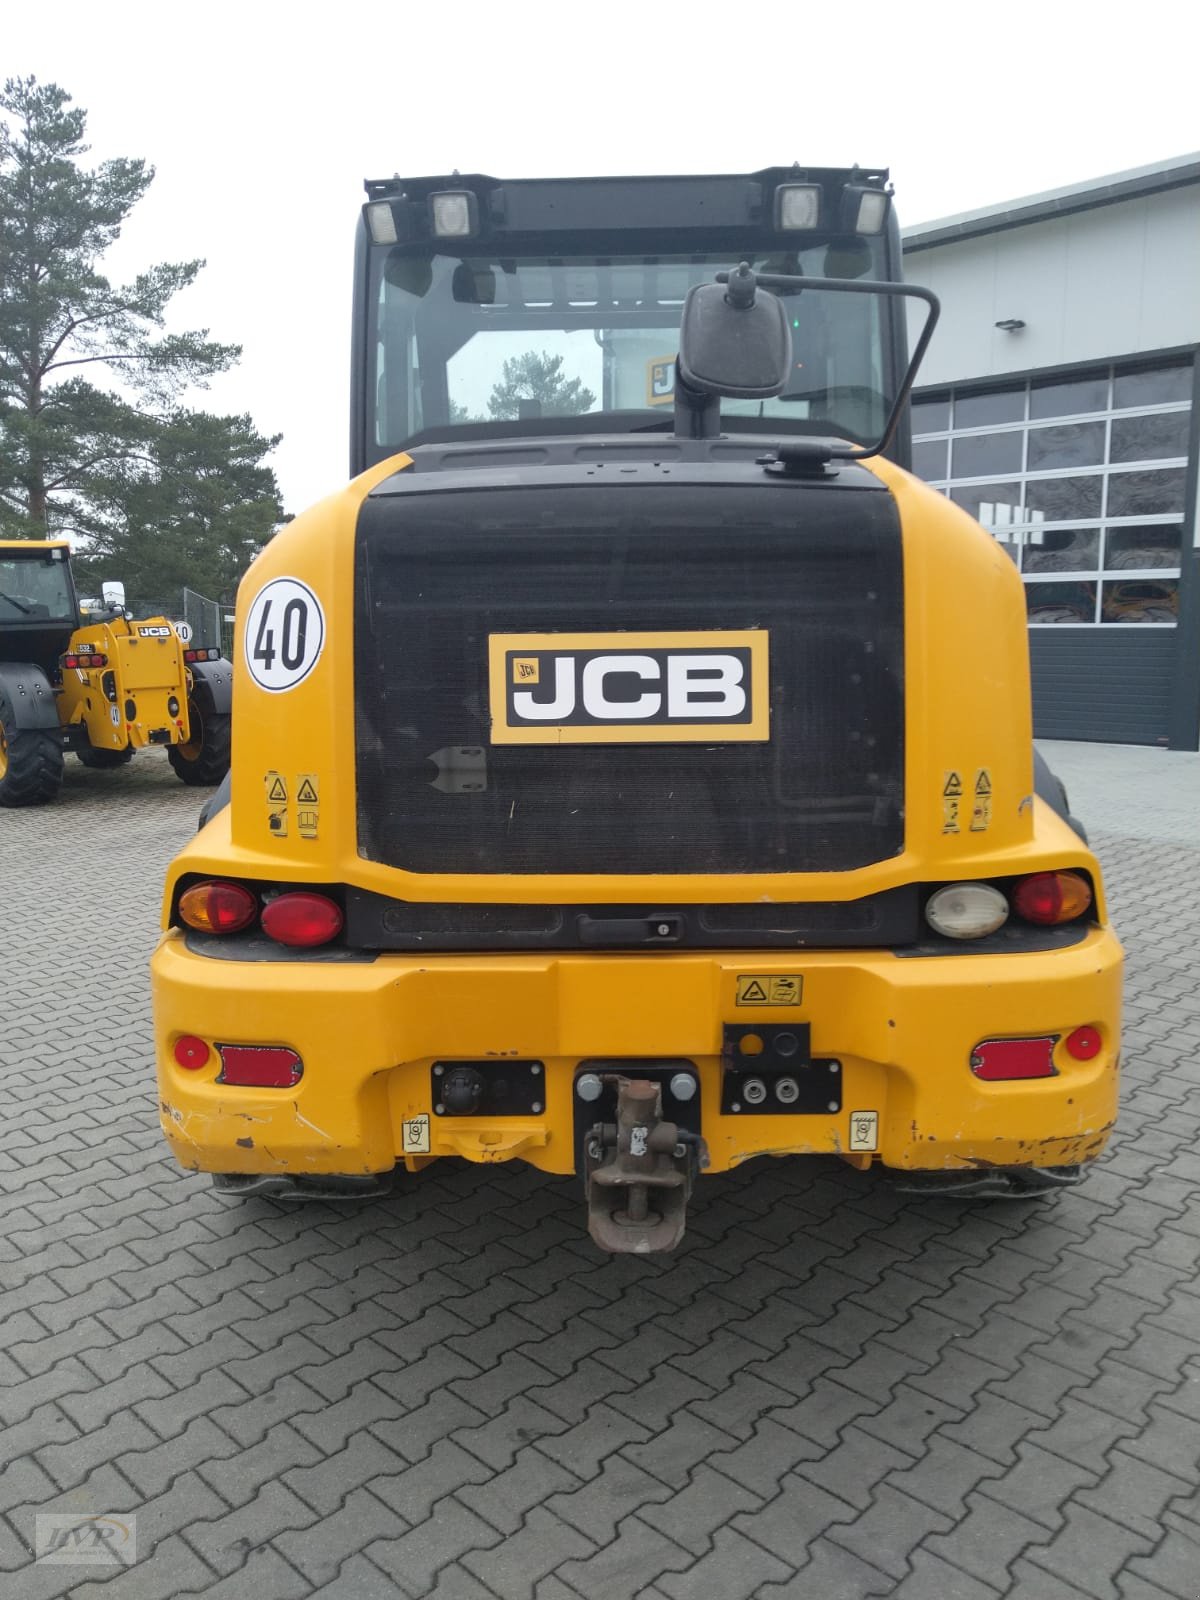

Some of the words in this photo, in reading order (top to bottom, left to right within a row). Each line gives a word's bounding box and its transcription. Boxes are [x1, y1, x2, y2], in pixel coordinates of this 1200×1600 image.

[140, 627, 171, 637] JCB
[253, 598, 308, 671] 40
[513, 654, 746, 720] JCB
[519, 664, 535, 678] JCB
